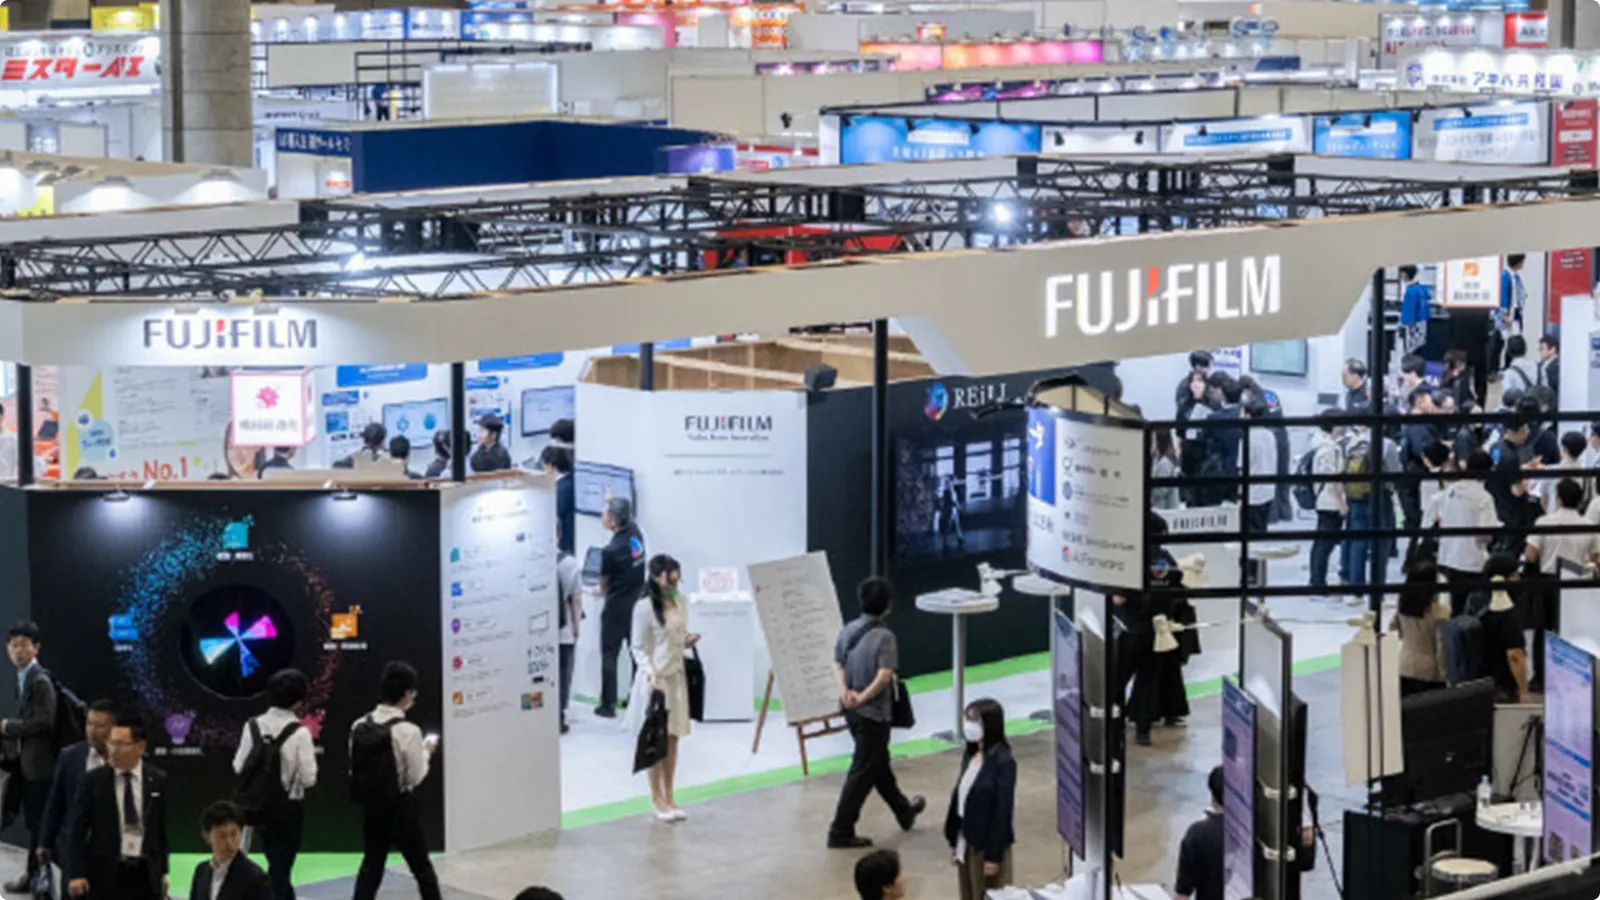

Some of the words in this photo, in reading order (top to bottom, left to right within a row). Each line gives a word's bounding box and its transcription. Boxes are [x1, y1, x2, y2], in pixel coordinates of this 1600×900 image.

[1044, 253, 1281, 339] FUJIFILM
[142, 318, 318, 350] FUJIFILM
[684, 415, 772, 431] FUJIFILM
